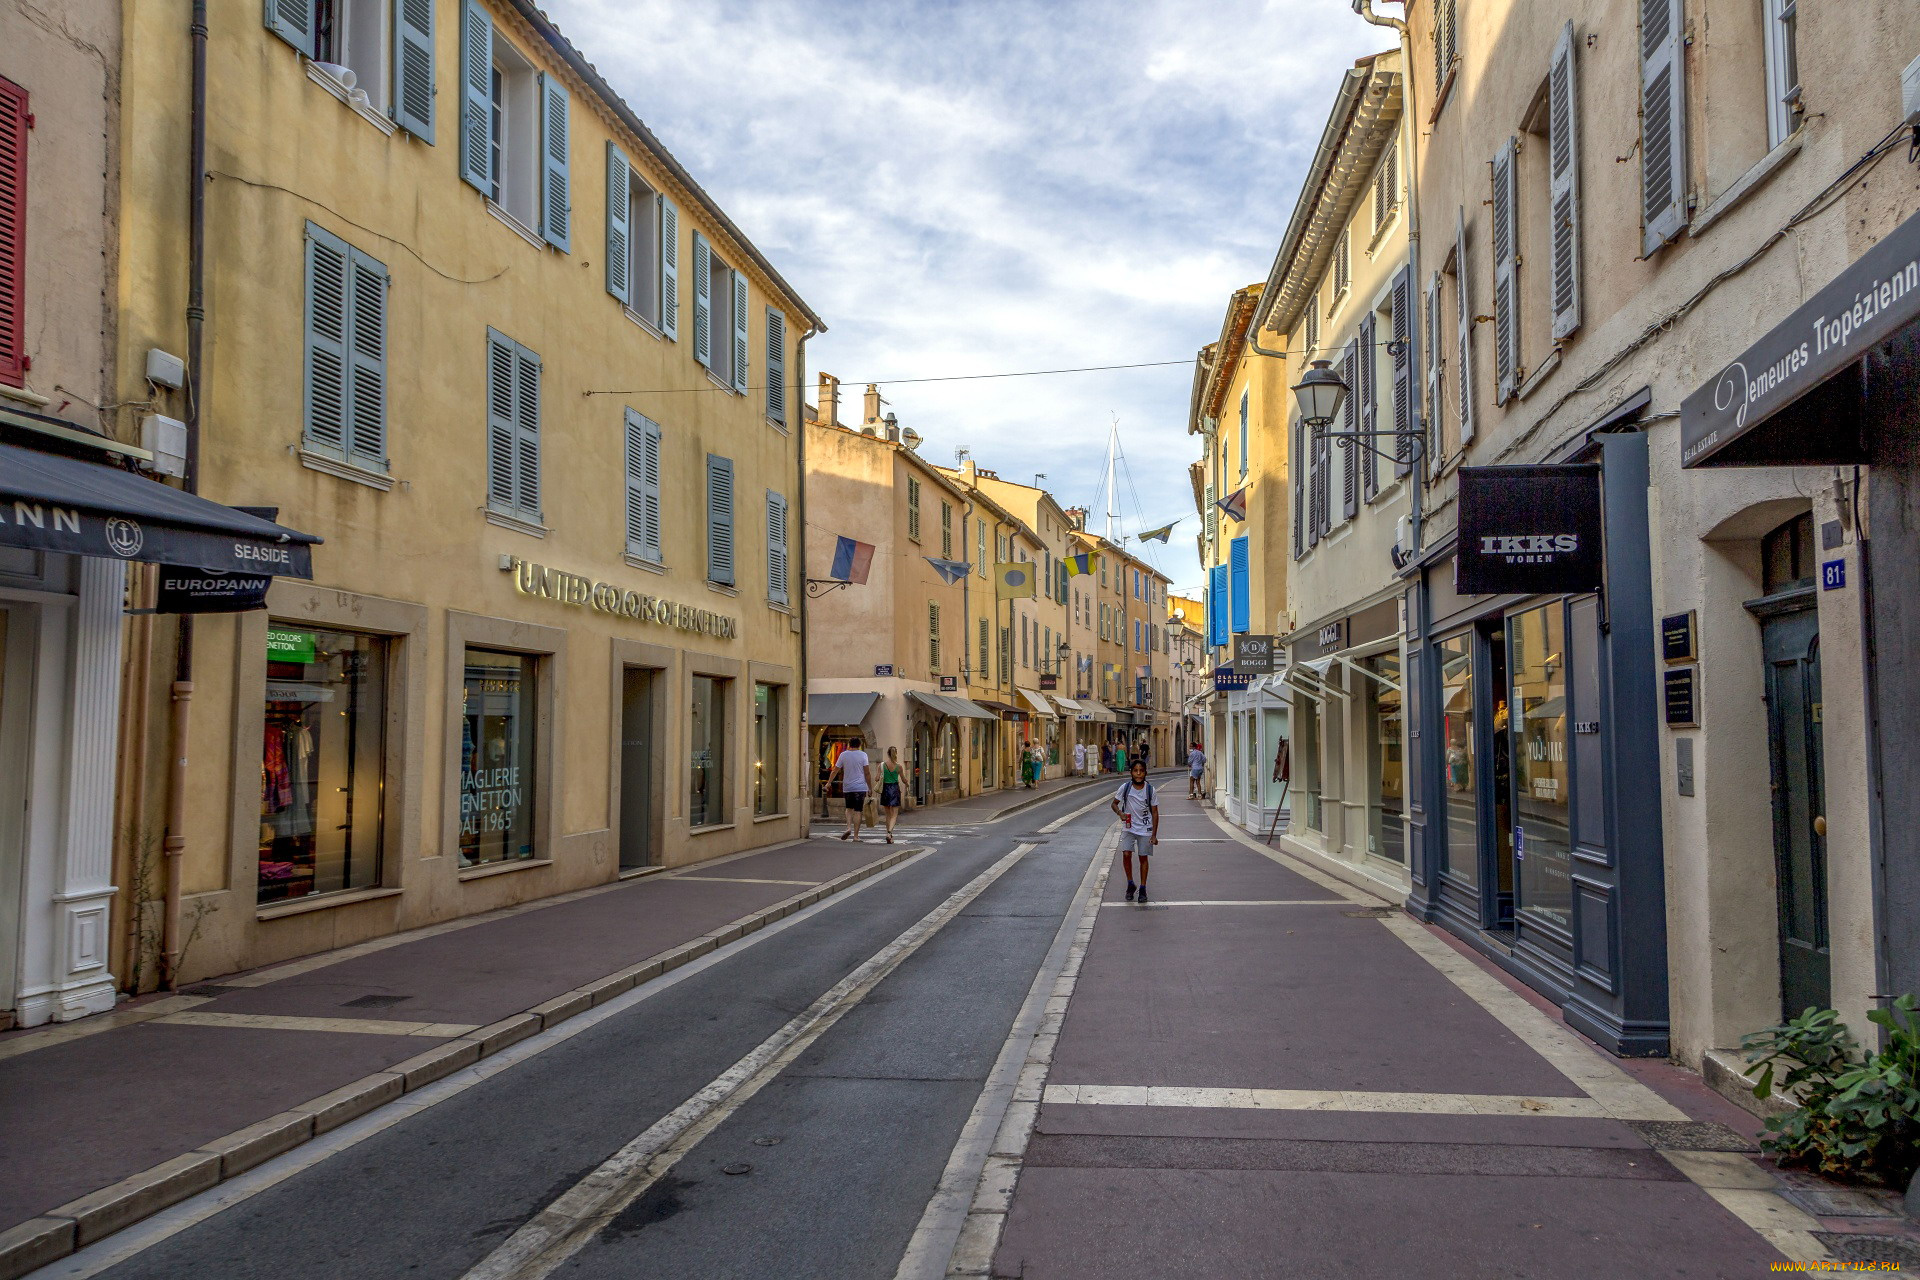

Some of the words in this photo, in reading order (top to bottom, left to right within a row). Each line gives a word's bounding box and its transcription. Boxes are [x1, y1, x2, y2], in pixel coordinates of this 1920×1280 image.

[1715, 341, 1809, 427] Demeures
[1813, 258, 1920, 355] Tropézienn
[1698, 430, 1718, 452] ESTATE
[0, 501, 80, 534] NN
[234, 543, 290, 563] SEASIDE
[1480, 534, 1578, 553] IKKS
[1506, 554, 1552, 563] WOMEN
[1827, 565, 1839, 584] 81
[164, 579, 266, 590] EUROPANN
[517, 561, 592, 605] UNITED
[592, 581, 657, 622] COLORS
[656, 599, 678, 626] OF
[276, 633, 302, 643] COLORS
[1319, 623, 1338, 646] BOGGI
[1575, 722, 1599, 733] IKKS
[1547, 742, 1563, 761] IKKS
[483, 810, 512, 833] 1965
